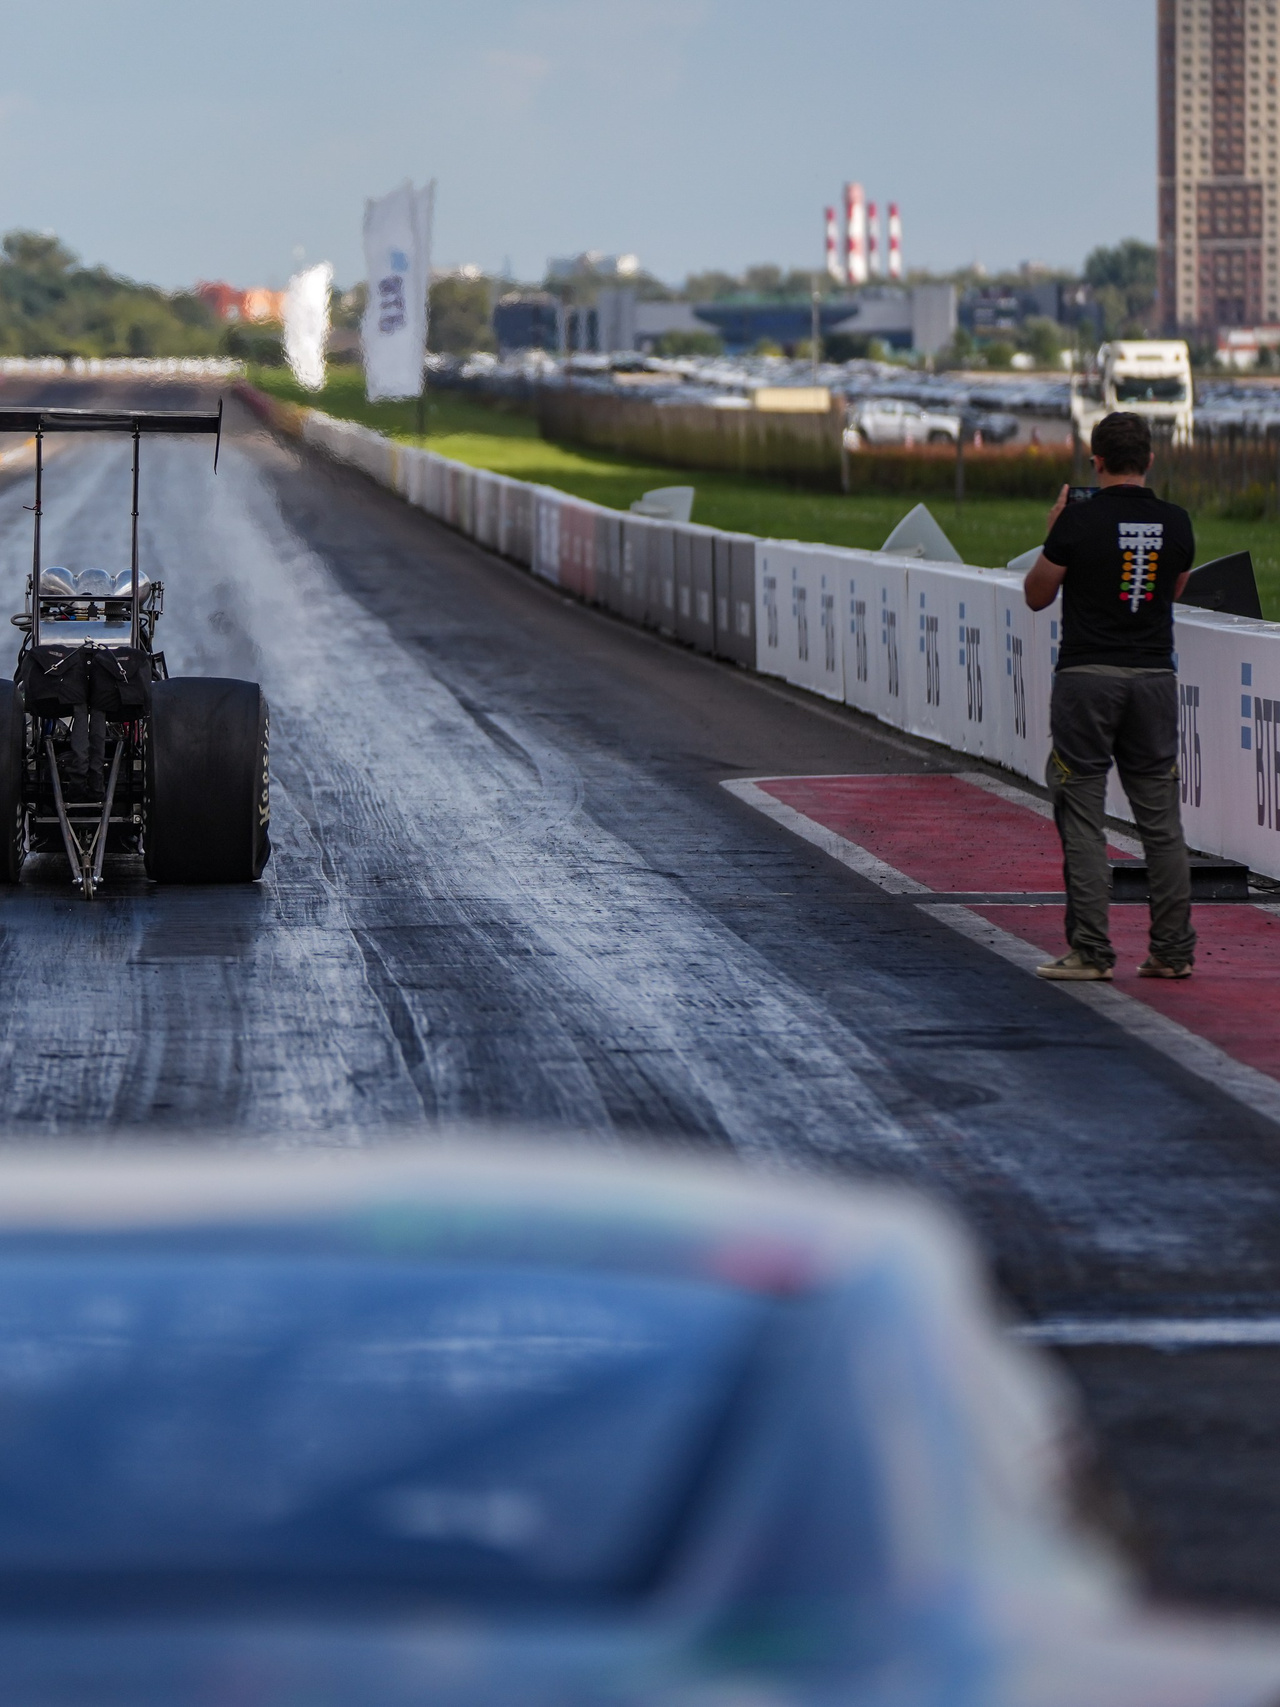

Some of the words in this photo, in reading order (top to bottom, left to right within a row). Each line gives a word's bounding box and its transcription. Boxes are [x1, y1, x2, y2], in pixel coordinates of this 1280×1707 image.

[926, 614, 940, 707] ВТБ
[966, 625, 983, 723] ВТБ
[1012, 634, 1026, 740] ВТБ
[1180, 683, 1202, 808] ВТБ
